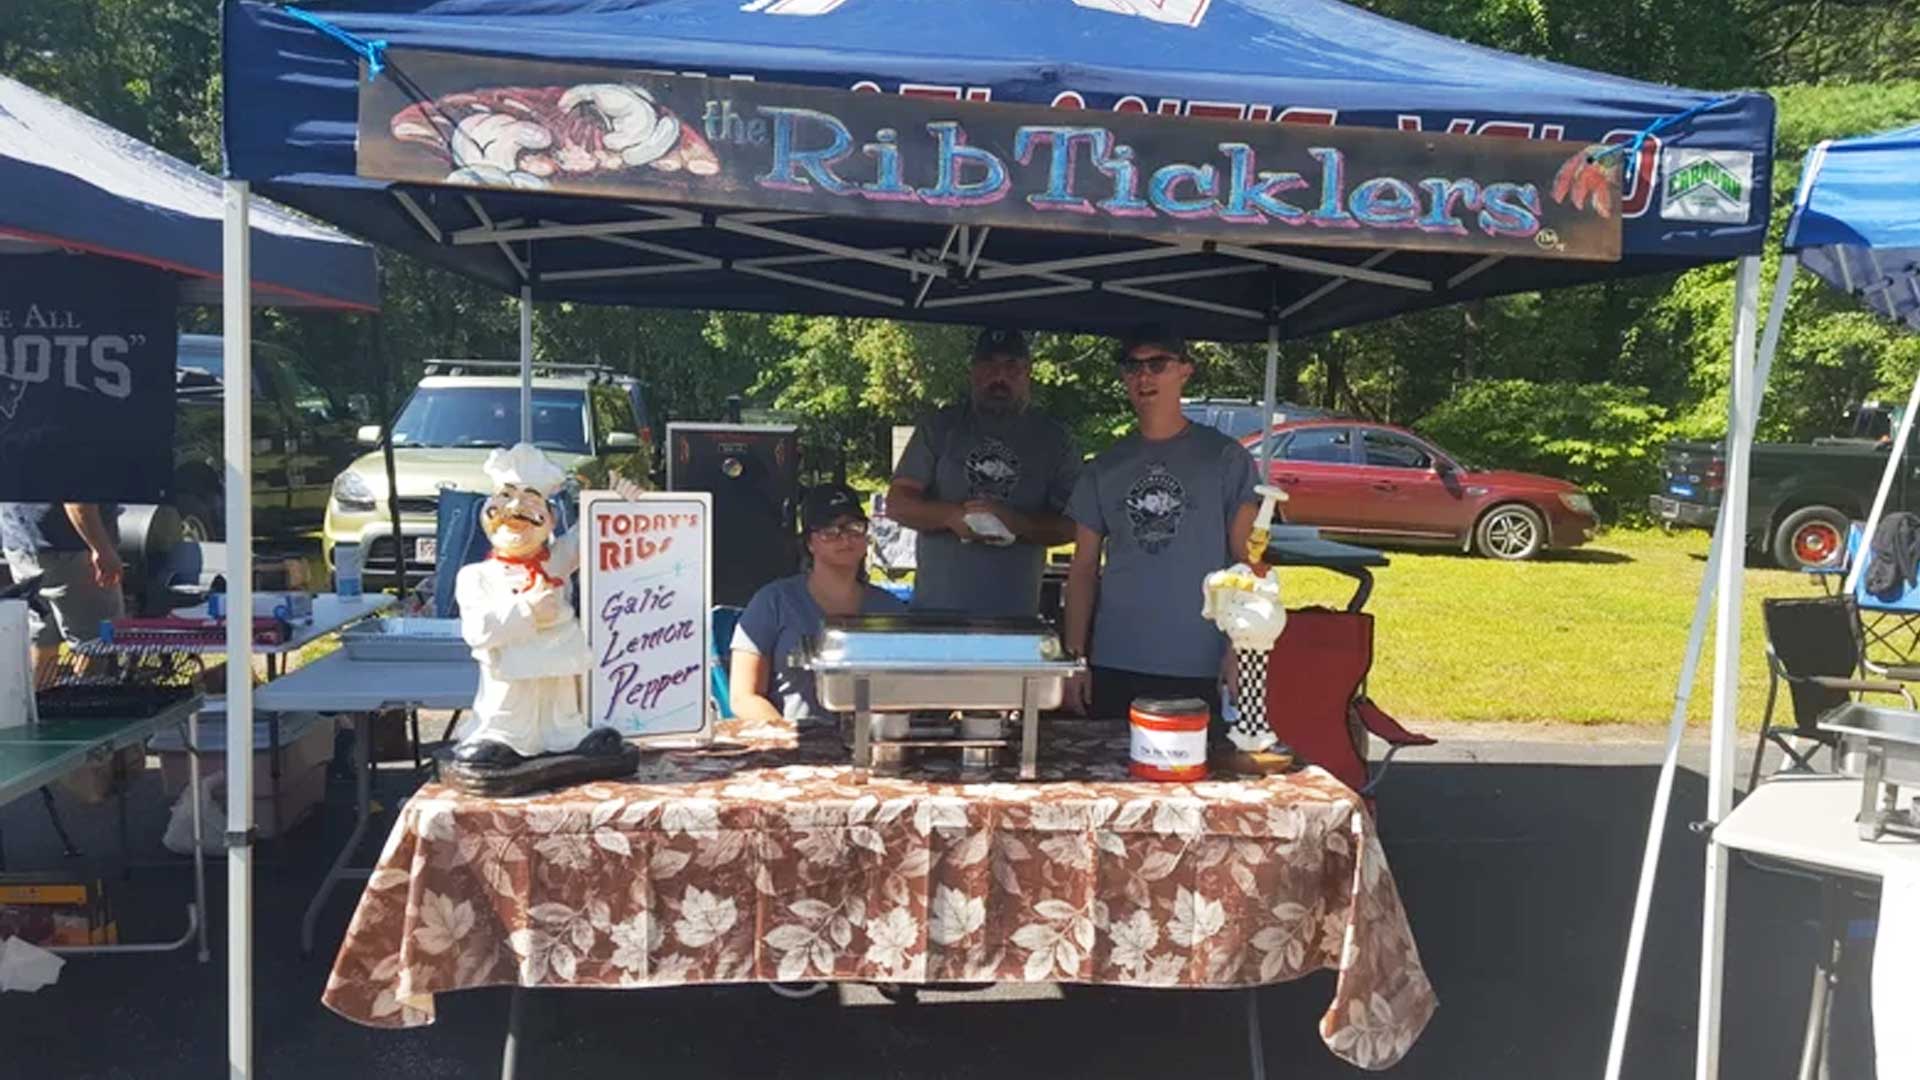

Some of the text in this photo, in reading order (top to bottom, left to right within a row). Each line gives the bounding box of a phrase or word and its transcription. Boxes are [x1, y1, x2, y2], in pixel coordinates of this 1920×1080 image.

[702, 99, 767, 146] the
[597, 513, 698, 537] TODAY'S
[601, 586, 676, 630] Galic
[600, 619, 694, 668] Lemon
[603, 662, 700, 720] Pepper
